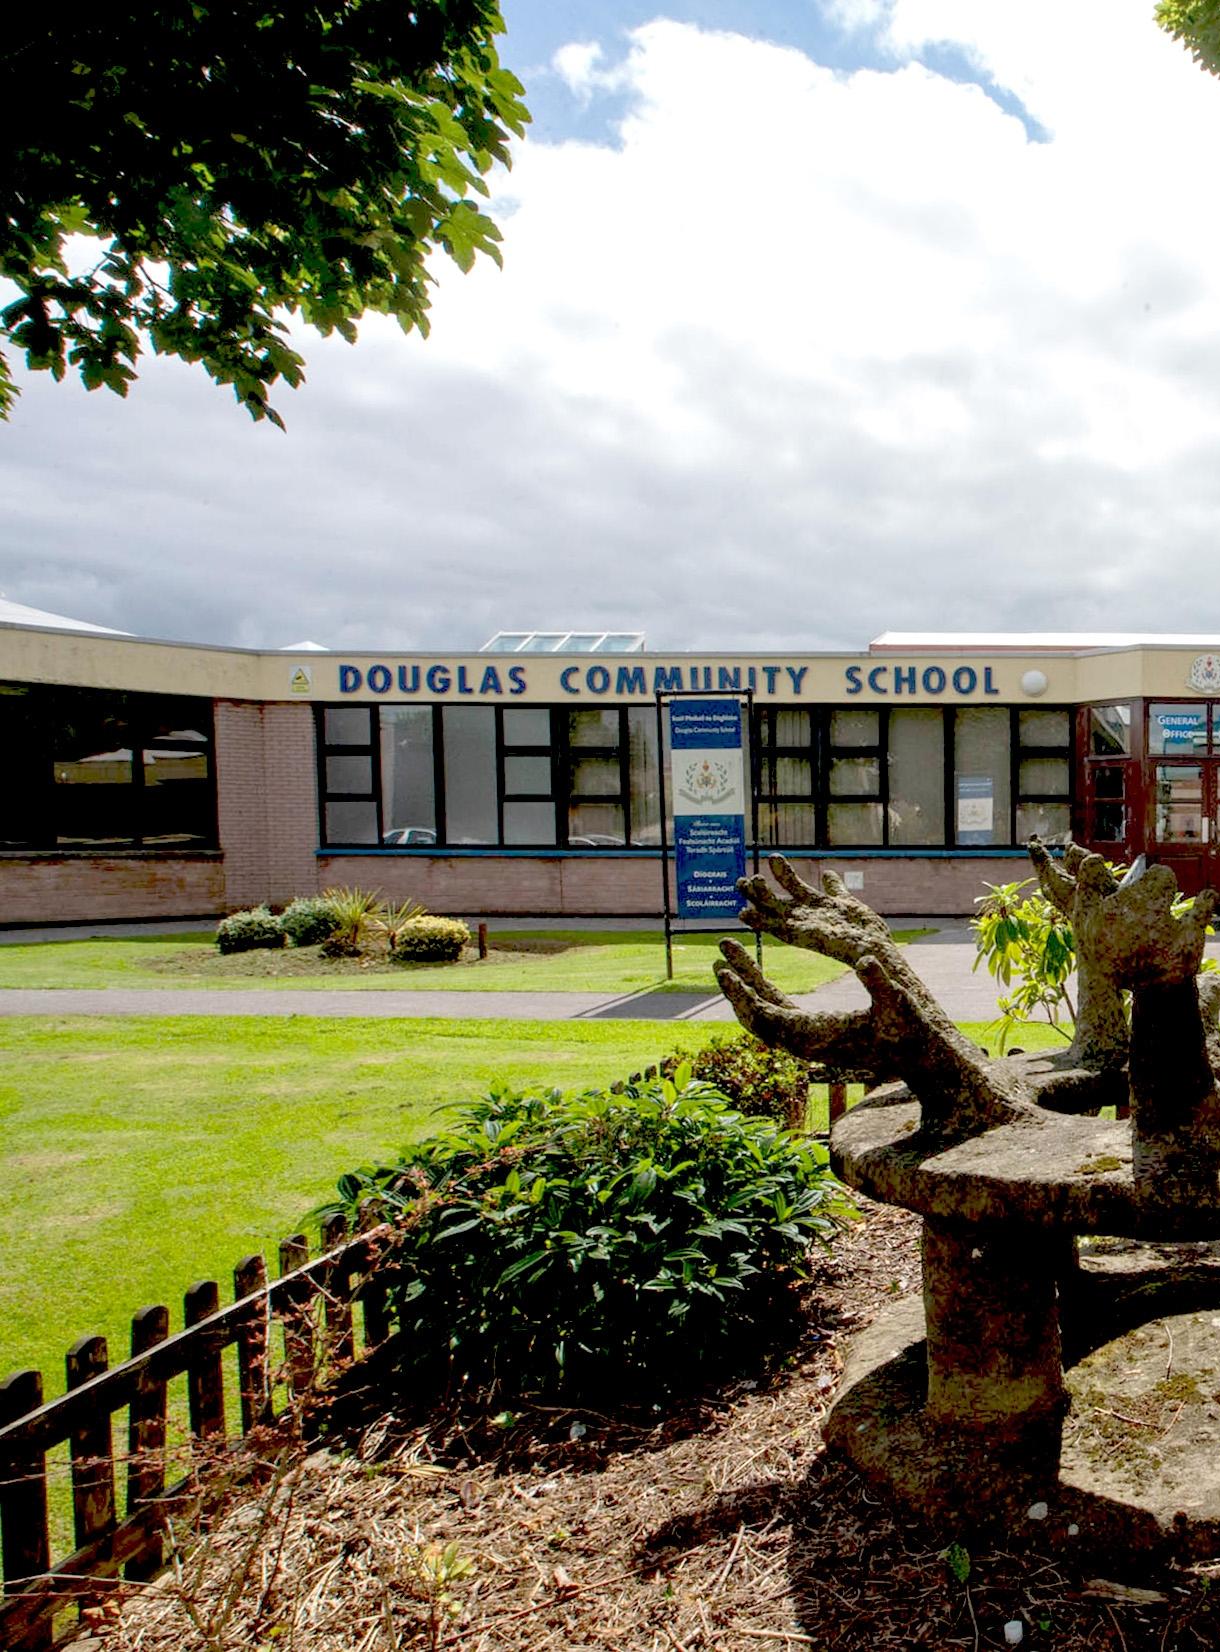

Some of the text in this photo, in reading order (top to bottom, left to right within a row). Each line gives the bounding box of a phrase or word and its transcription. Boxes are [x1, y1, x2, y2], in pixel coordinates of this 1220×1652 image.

[338, 664, 1000, 696] DOUGLAS COMMUNITY SCHOOL
[1156, 715, 1199, 726] GENERAL
[1162, 729, 1194, 739] OFFICE
